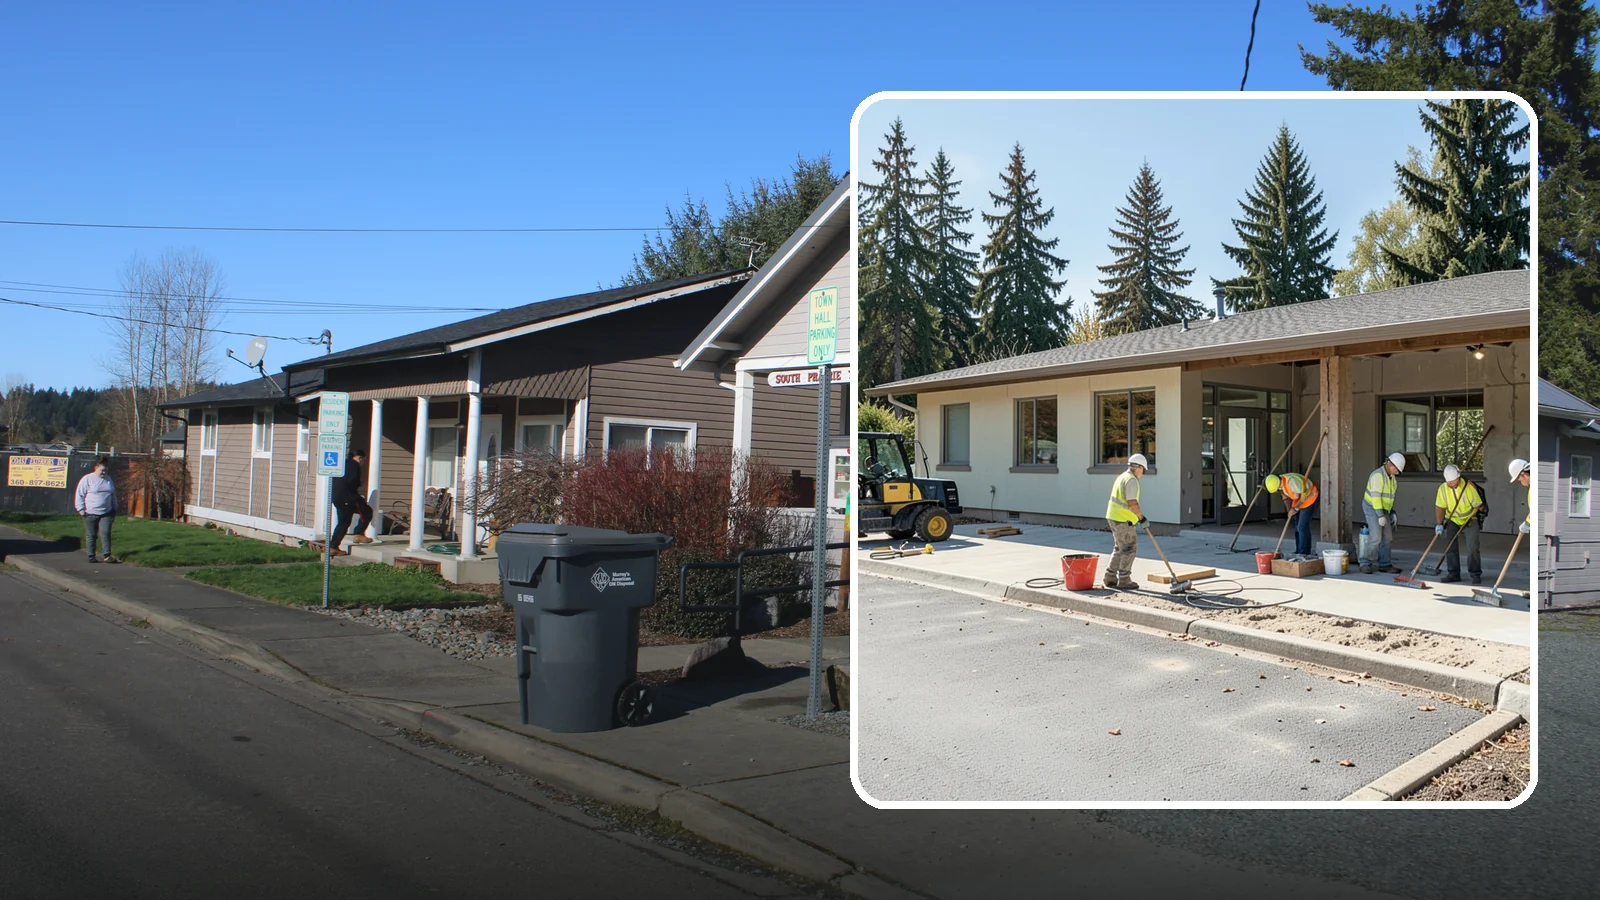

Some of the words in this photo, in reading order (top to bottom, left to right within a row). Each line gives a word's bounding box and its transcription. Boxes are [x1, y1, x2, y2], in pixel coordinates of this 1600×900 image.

[815, 295, 833, 308] TOWN
[814, 311, 831, 325] HALL
[810, 326, 836, 340] PARKING
[813, 344, 831, 357] ONLY
[775, 373, 801, 384] SOUTH
